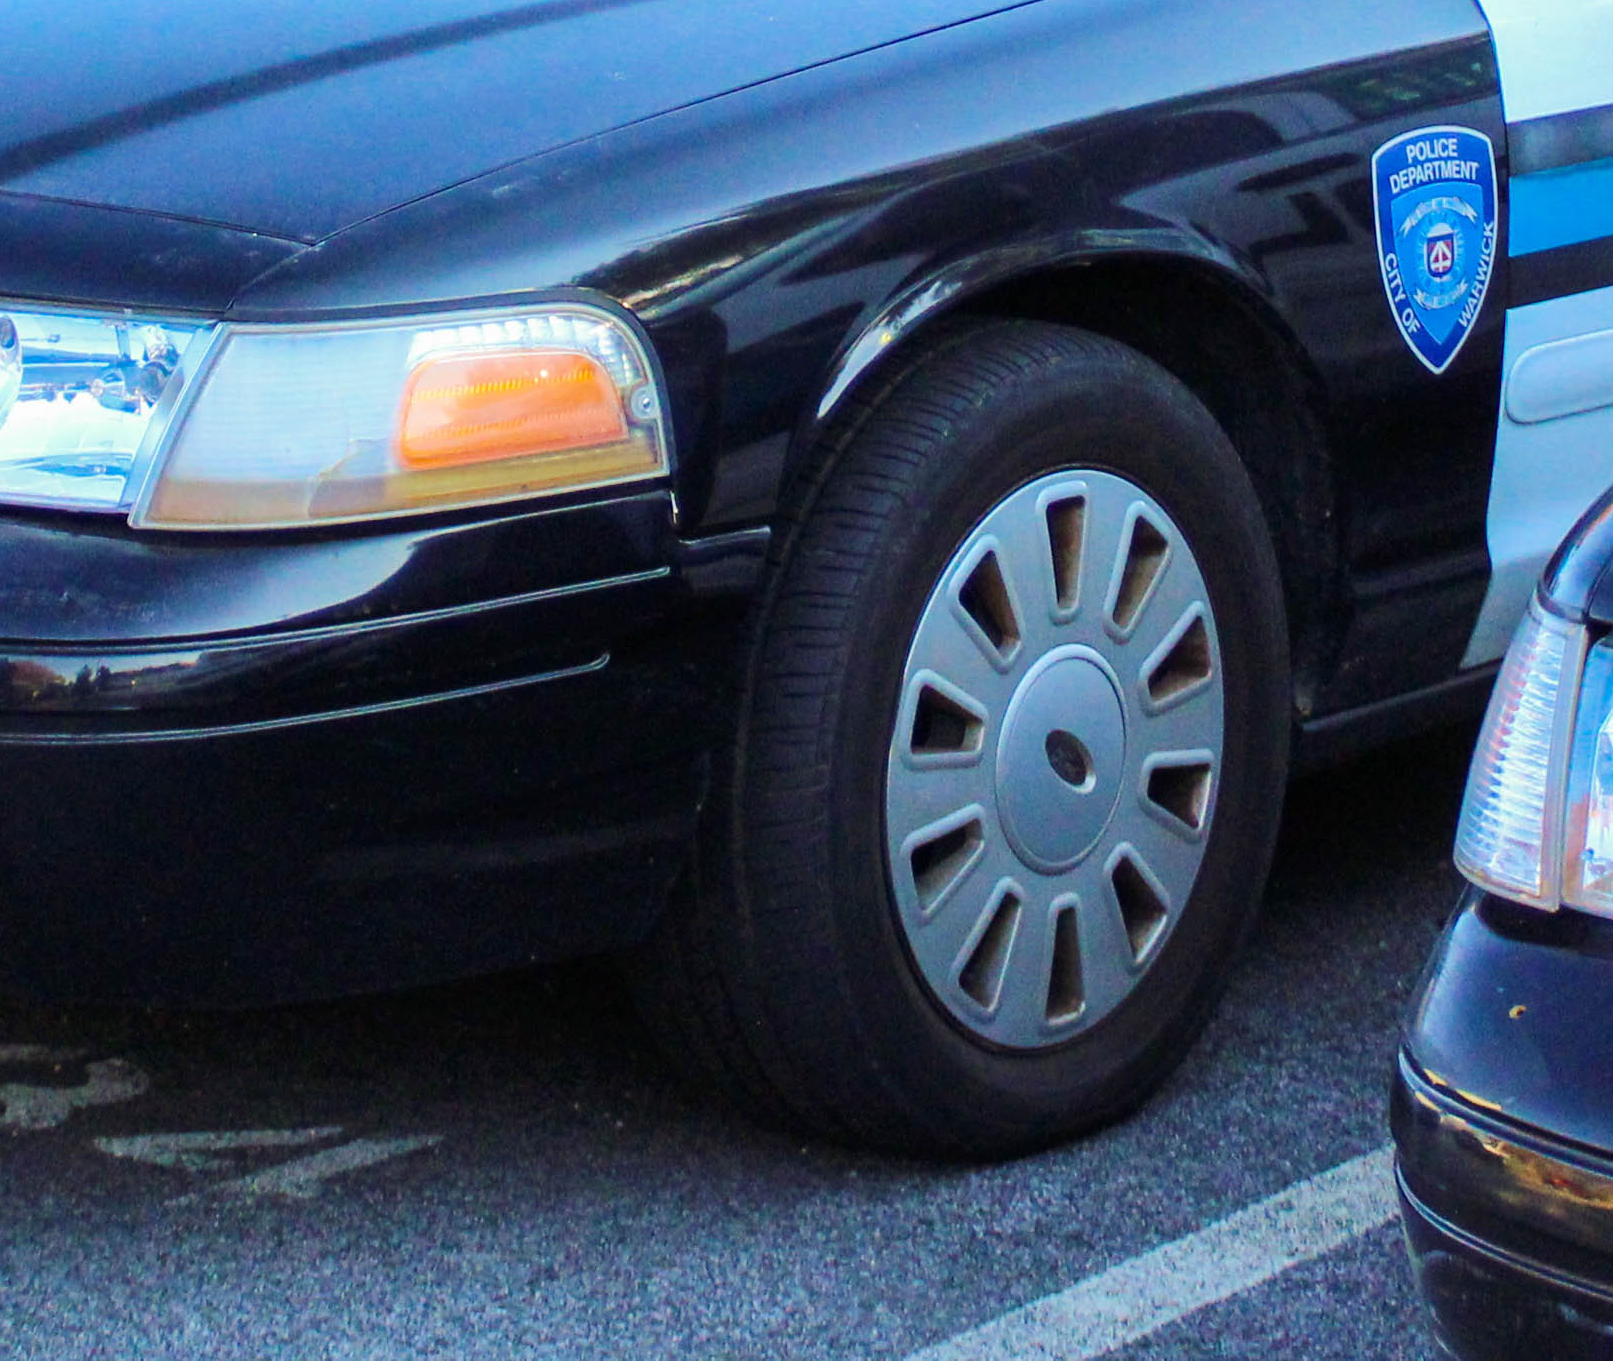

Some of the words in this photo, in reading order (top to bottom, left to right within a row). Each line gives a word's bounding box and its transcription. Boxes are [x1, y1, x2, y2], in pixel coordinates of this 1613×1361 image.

[1389, 161, 1481, 195] DEPARTMENT
[1405, 138, 1459, 164] POLICE
[1384, 252, 1407, 304] CITY
[1401, 308, 1421, 335] OF
[1458, 220, 1494, 329] WARWICK
